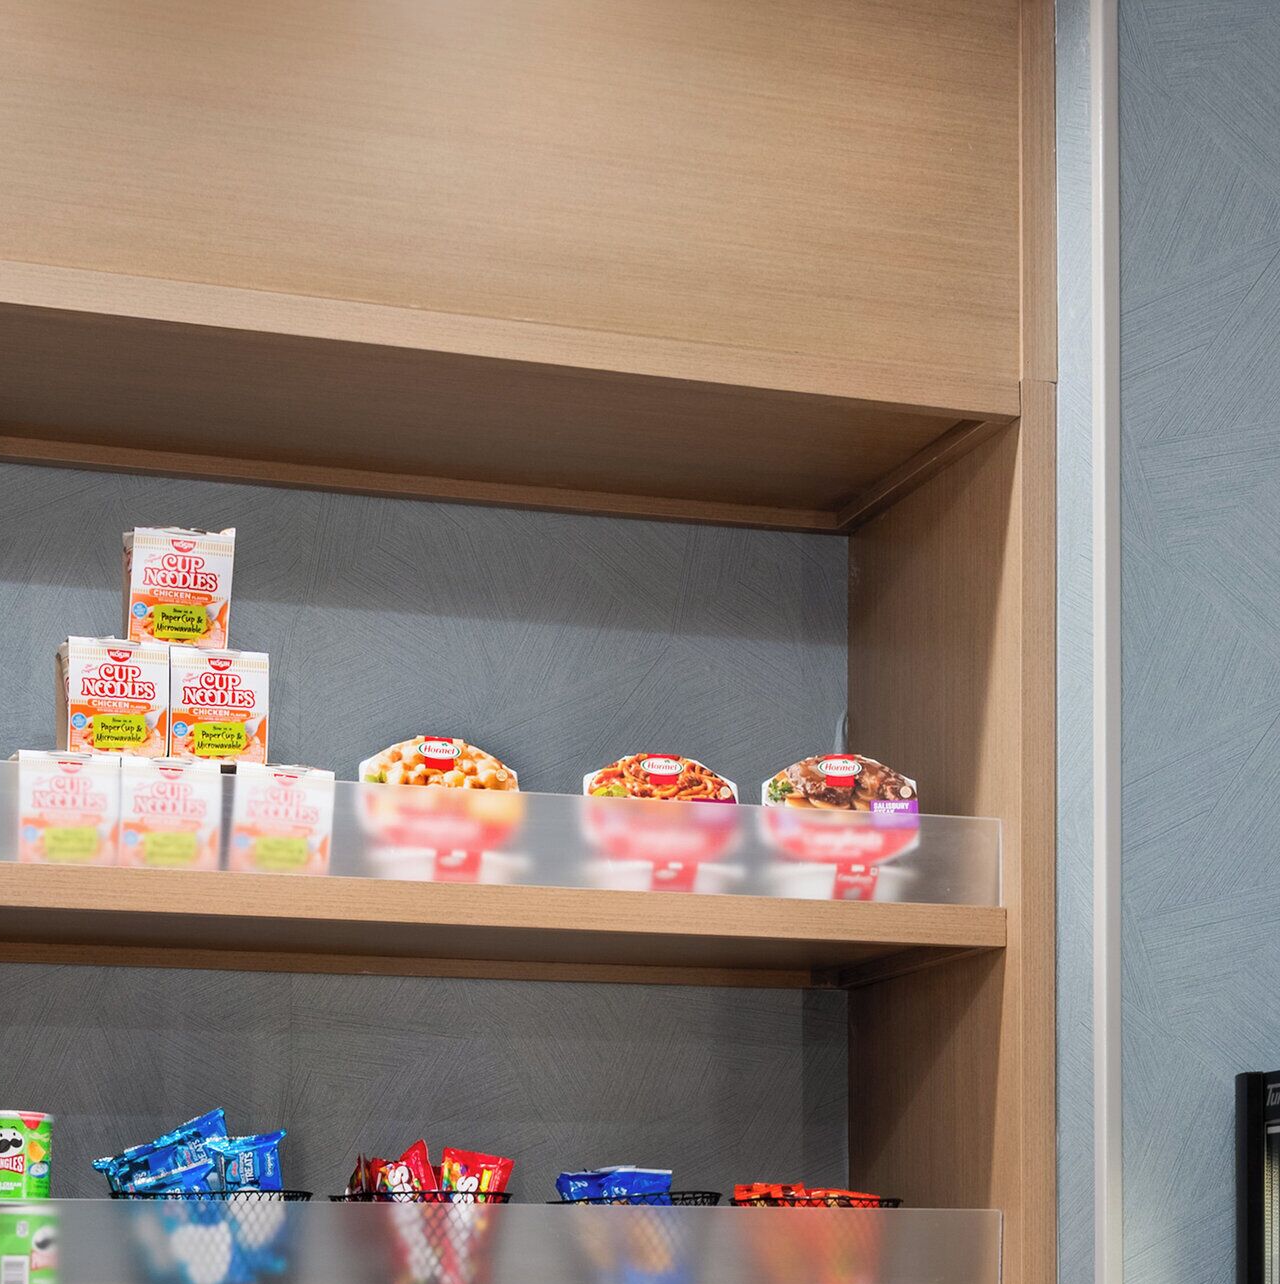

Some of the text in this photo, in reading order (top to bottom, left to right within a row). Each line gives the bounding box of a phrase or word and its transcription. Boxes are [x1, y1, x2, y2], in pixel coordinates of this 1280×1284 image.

[162, 554, 205, 573] CUP
[143, 568, 218, 592] NOODLES
[153, 590, 191, 599] CHICKEN
[99, 663, 141, 681] CUP
[199, 672, 241, 690] CUP
[81, 677, 156, 700] NOODLES
[182, 686, 255, 708] NOODLES
[421, 742, 457, 758] Hormel
[644, 758, 682, 774] Hormel
[821, 758, 858, 774] Hormel
[872, 801, 910, 811] SALISBURY
[245, 1151, 255, 1182] TREATS
